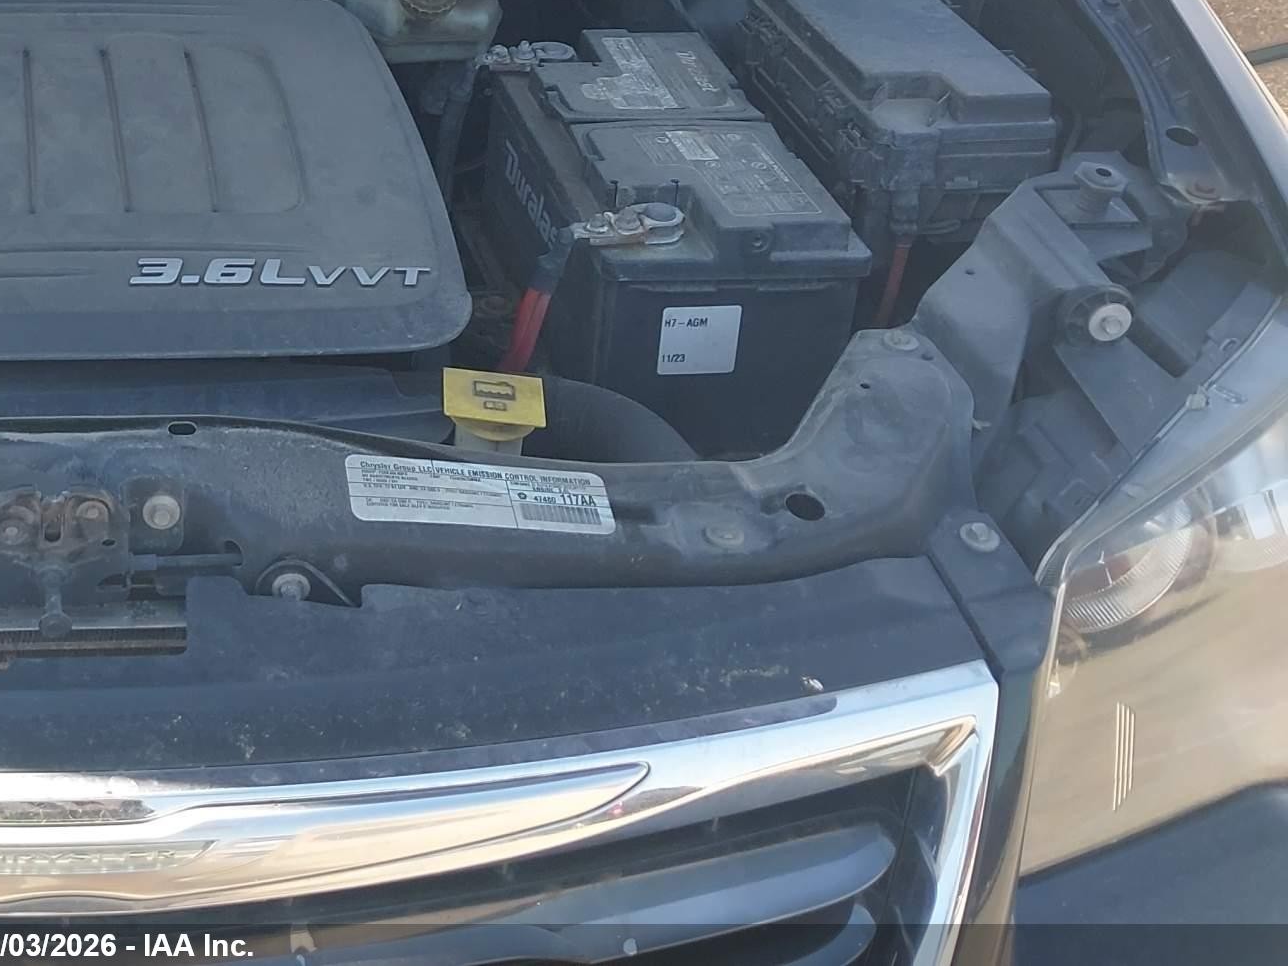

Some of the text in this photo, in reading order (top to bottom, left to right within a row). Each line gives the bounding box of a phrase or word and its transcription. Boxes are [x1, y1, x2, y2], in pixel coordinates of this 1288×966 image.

[505, 138, 560, 251] Duralas
[661, 353, 686, 363] 11/23
[360, 460, 392, 471] Chrysler
[393, 463, 416, 473] Group
[435, 466, 465, 476] VEHICLE
[467, 468, 503, 480] EMISSION
[505, 472, 538, 483] CONTROL
[539, 475, 592, 486] INFORMATION
[560, 493, 598, 508] 117AA
